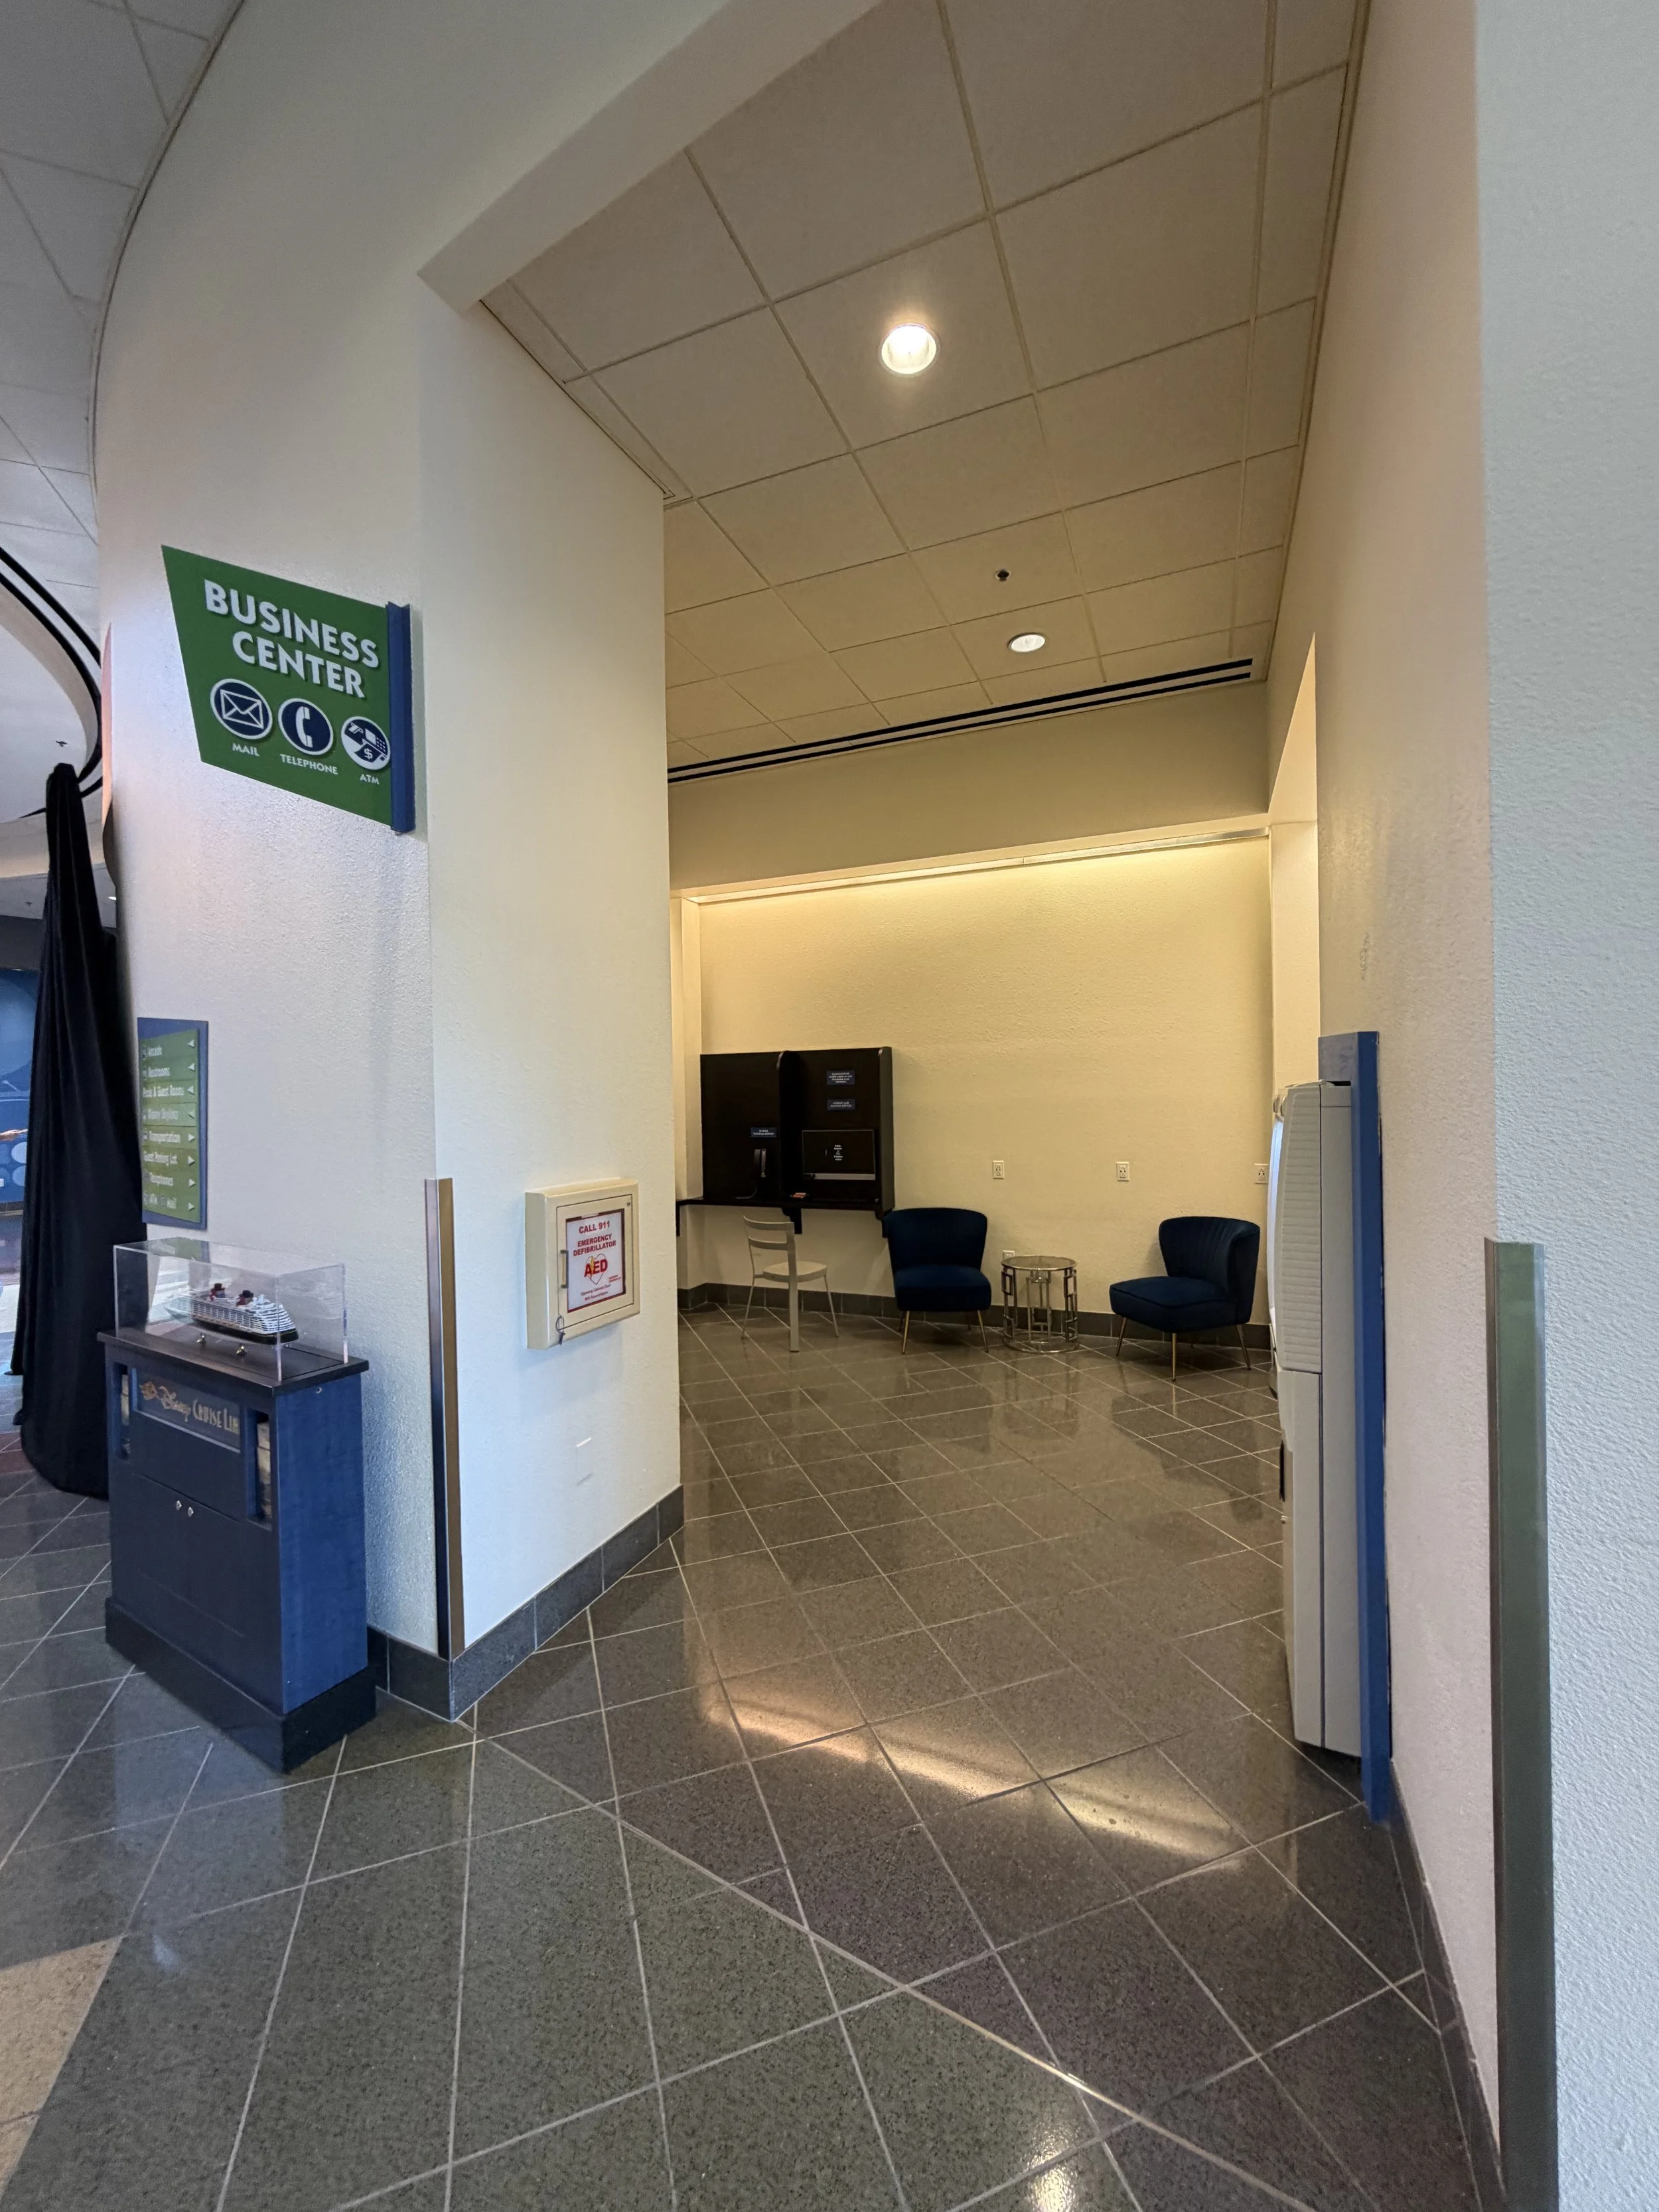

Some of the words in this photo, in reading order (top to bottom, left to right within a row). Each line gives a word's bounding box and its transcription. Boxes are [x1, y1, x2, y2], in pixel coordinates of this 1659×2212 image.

[204, 579, 380, 668] BUSINESS
[233, 631, 365, 698] CENTER
[232, 742, 260, 757] MAIL
[280, 754, 338, 775] TELEPHONE
[360, 774, 380, 785] ATM
[579, 1224, 597, 1234] CALL
[599, 1220, 610, 1230] 911
[573, 1240, 616, 1256] DEFIBRILLATOR
[577, 1234, 612, 1247] EMERGENCY
[584, 1258, 608, 1278] AED
